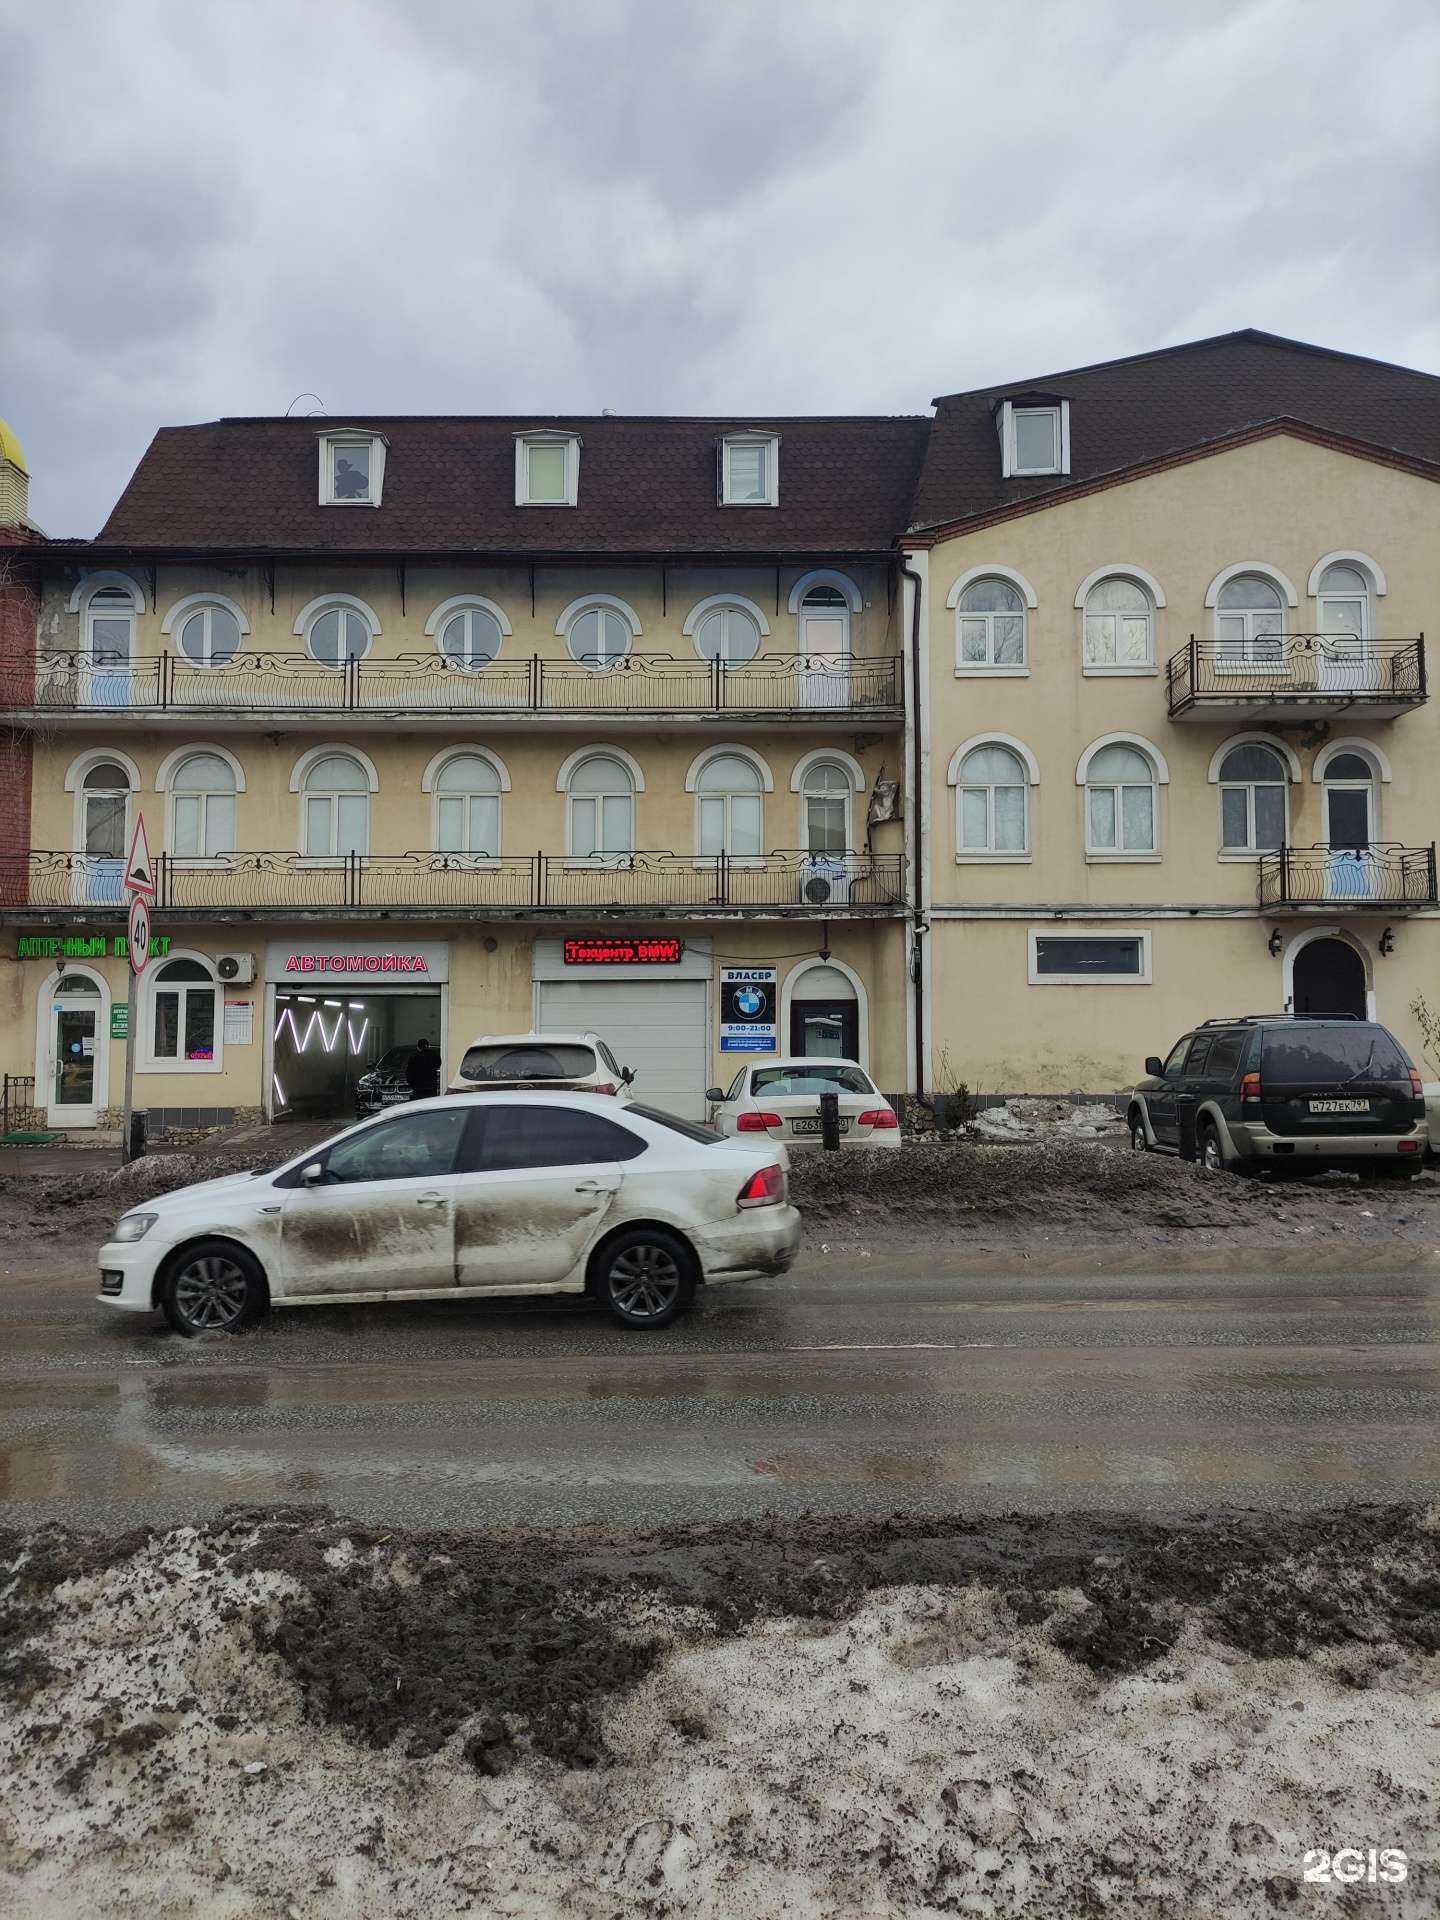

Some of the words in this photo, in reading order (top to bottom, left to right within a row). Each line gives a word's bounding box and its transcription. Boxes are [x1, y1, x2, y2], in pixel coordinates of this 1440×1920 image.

[134, 919, 146, 950] 40
[17, 933, 106, 957] АПТЕЧНЫЙ
[114, 936, 171, 957] ПКТ
[638, 945, 674, 957] BMW
[285, 953, 428, 972] АВТОМОЙКА
[727, 971, 772, 980] ВЛАСЕР
